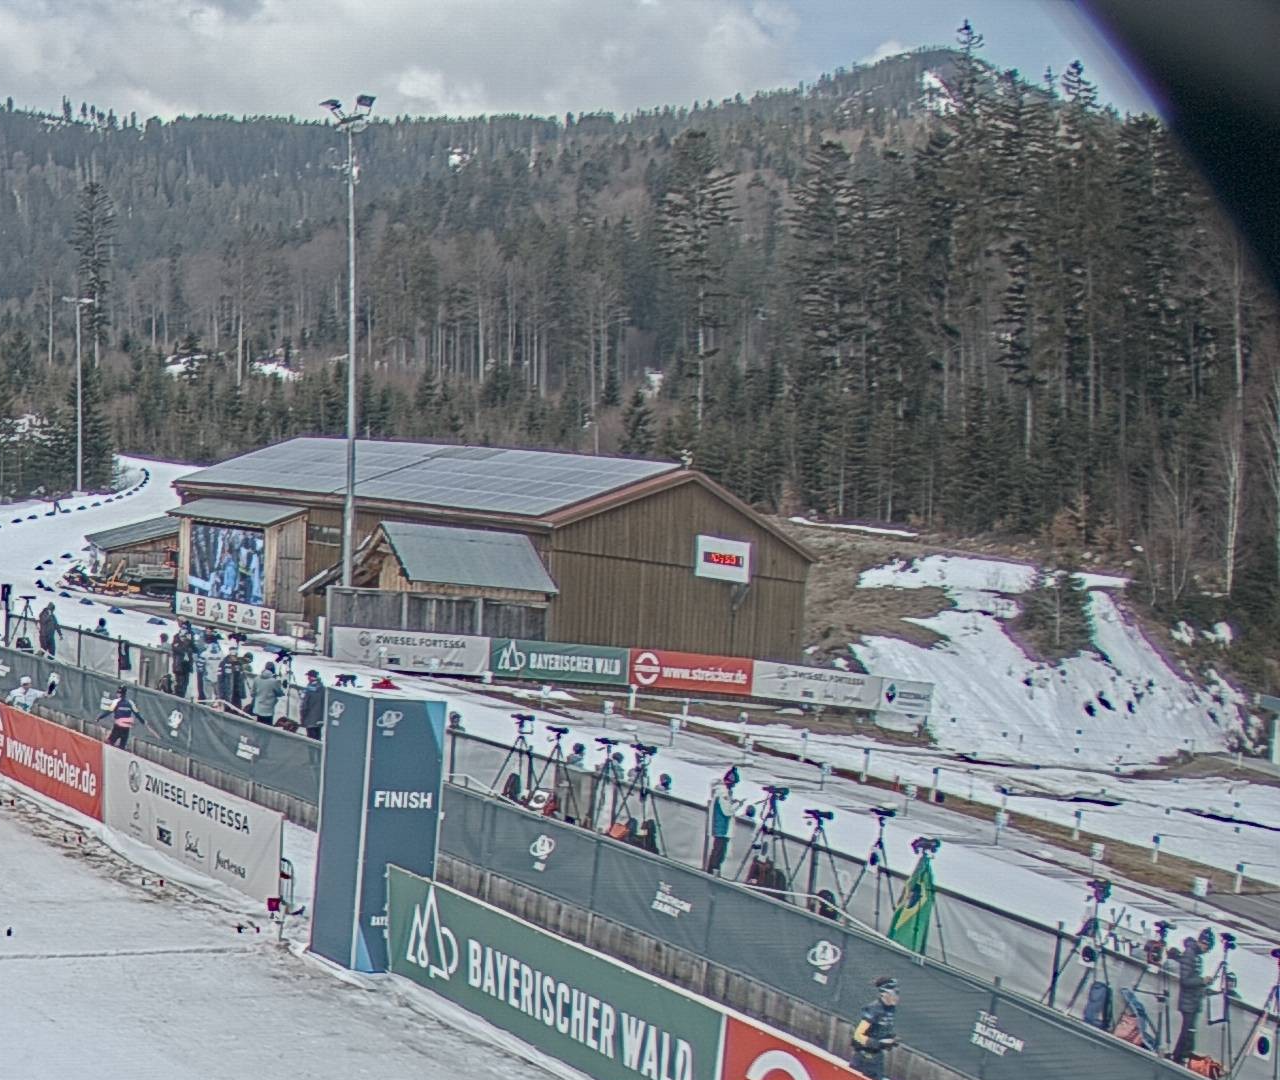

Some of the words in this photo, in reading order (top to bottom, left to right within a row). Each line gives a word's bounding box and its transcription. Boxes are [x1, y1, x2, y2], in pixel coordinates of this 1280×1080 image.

[374, 635, 418, 647] ZWIESEL
[419, 637, 466, 649] FORTESSA
[529, 652, 593, 673] BAYERISCHER
[595, 657, 621, 676] WALD
[5, 736, 97, 798] www.streicher.de
[144, 774, 191, 809] ZWIESEL
[191, 793, 251, 836] FORTESSA
[373, 789, 433, 809] FINISH
[467, 938, 616, 1060] BAYERISCHER
